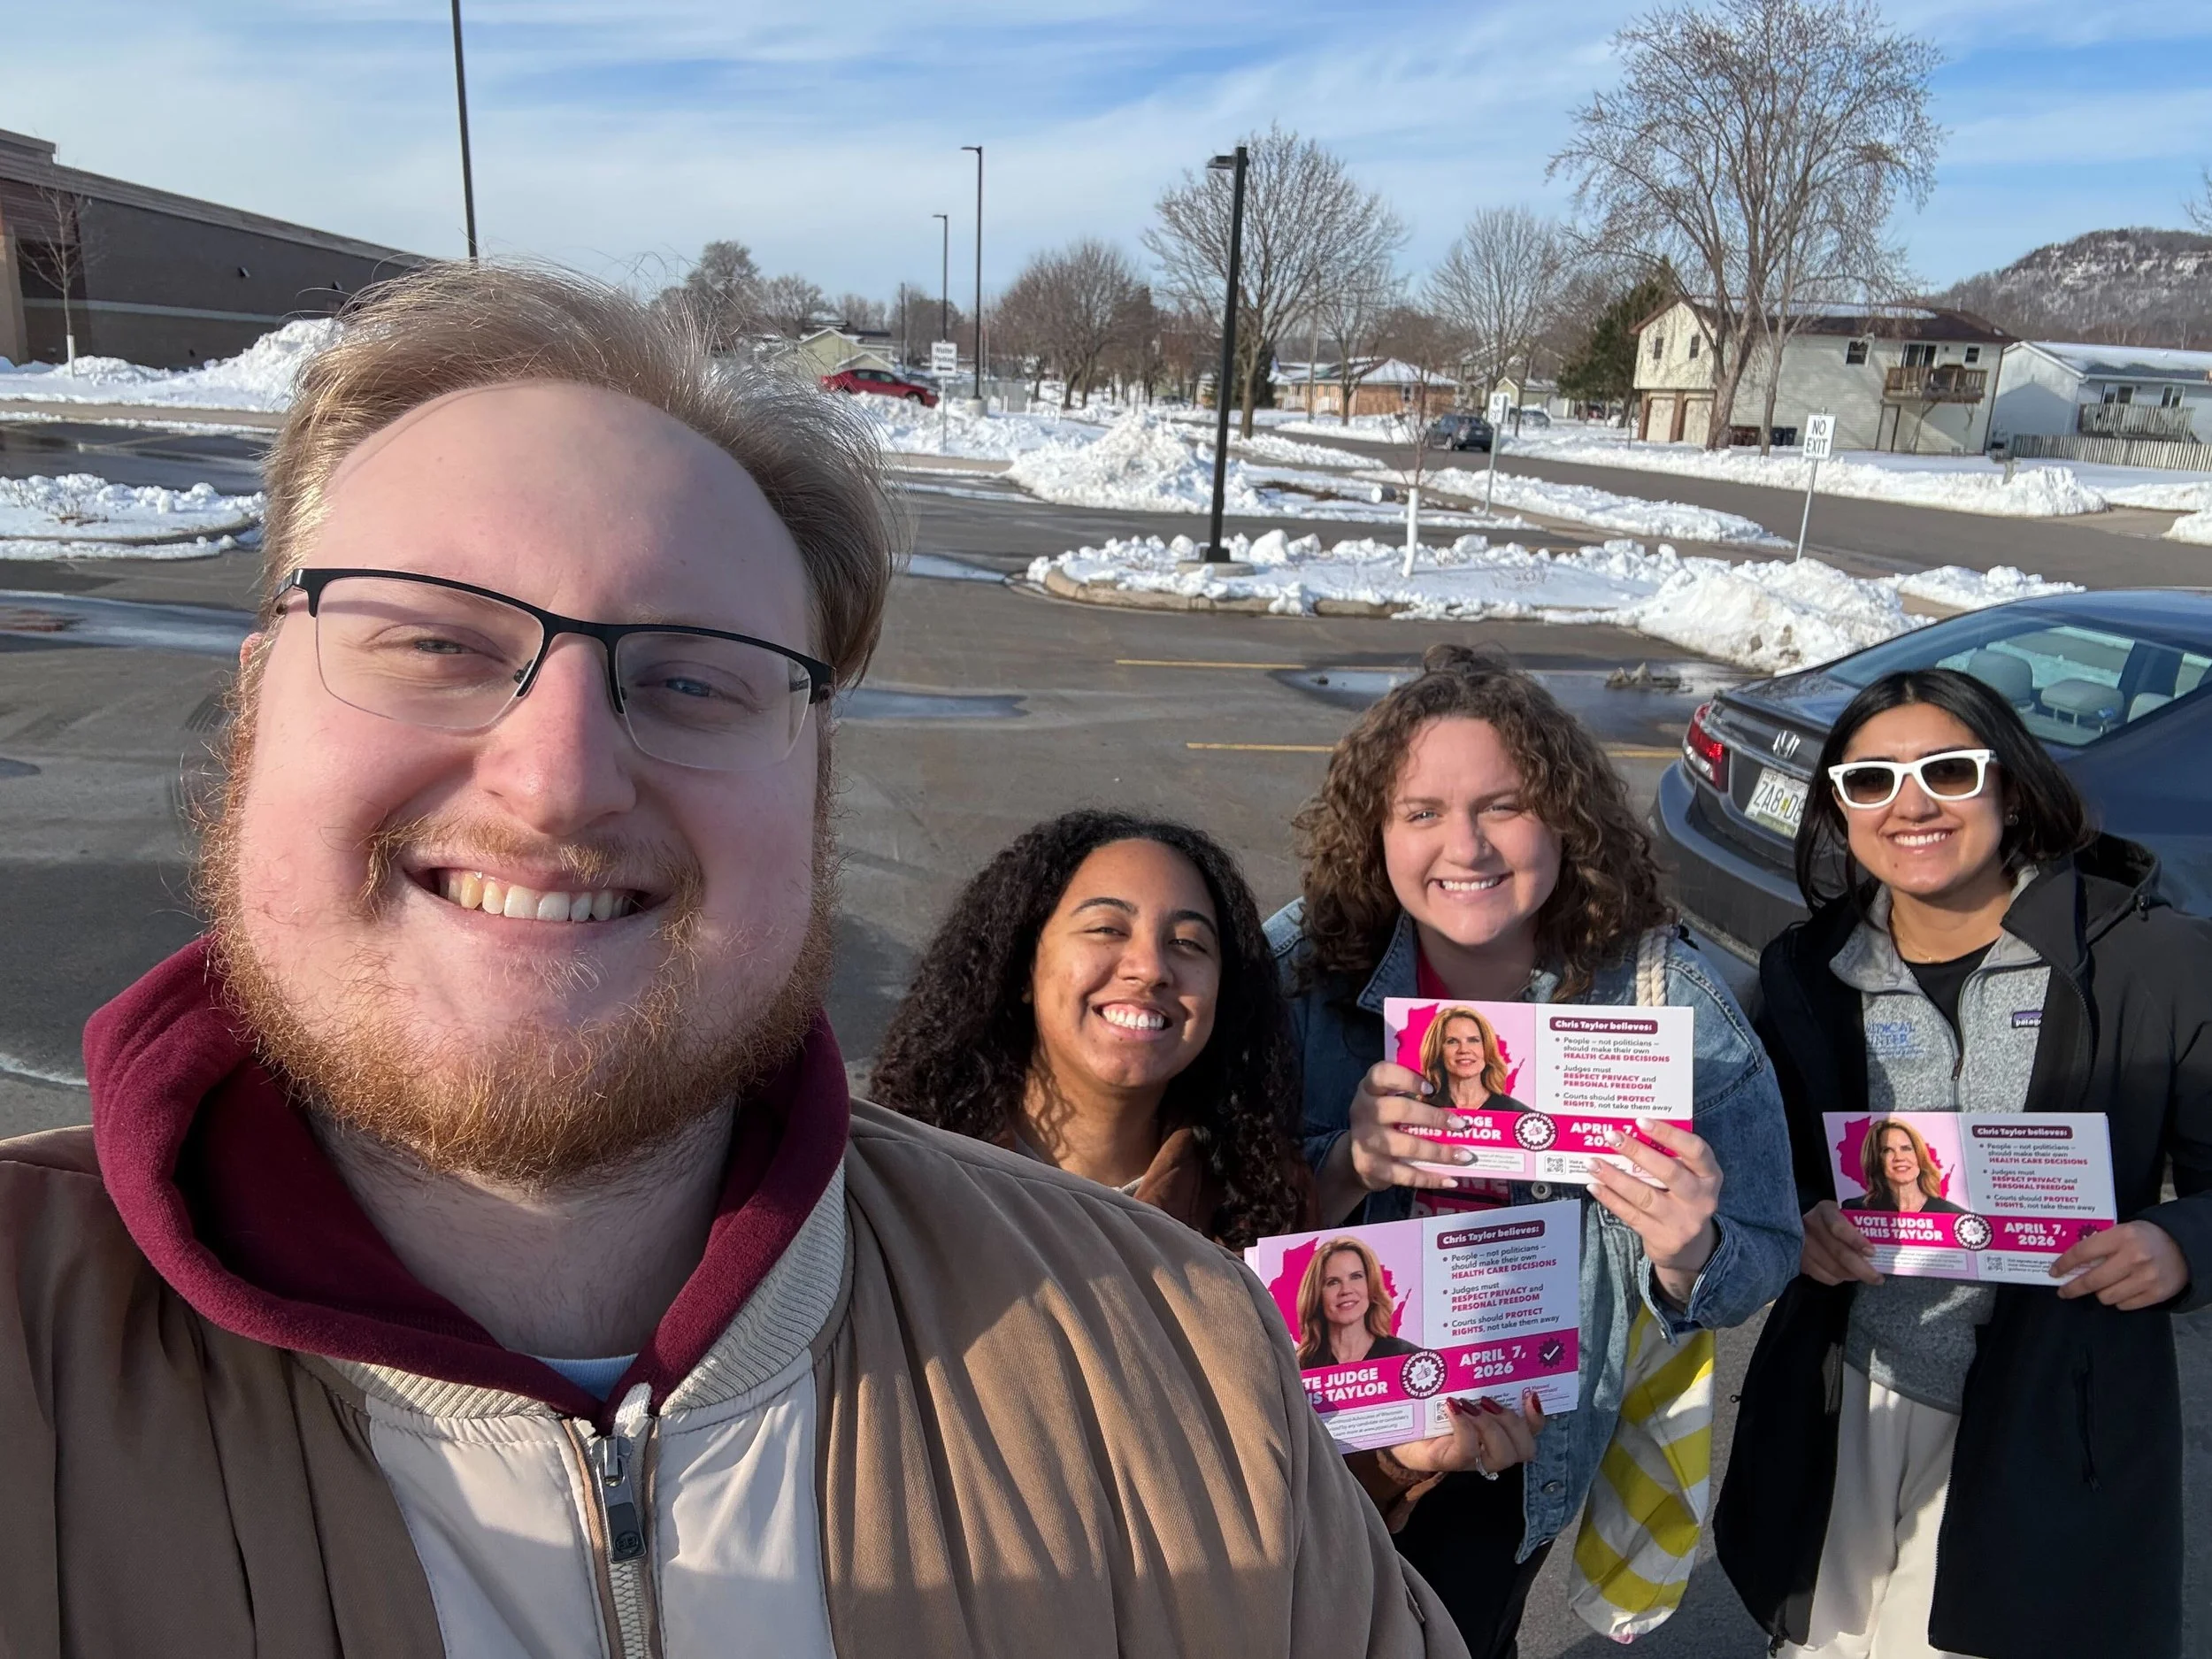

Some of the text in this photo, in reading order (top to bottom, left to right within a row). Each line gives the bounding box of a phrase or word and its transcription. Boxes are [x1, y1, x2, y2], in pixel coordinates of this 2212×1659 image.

[1812, 419, 1826, 435] NO
[1806, 437, 1828, 454] EXIT
[1579, 1021, 1608, 1031] Taylor
[1610, 1022, 1652, 1031] believes:
[1463, 1115, 1494, 1128] DGE
[1623, 1125, 1638, 1138] 7,
[2000, 1128, 2025, 1137] Taylor
[1583, 1136, 1611, 1148] 20
[1854, 1216, 1934, 1230] VOTE JUDGE
[2004, 1222, 2067, 1237] APRIL 7,
[1443, 1225, 1539, 1244] Chris Taylor believes:
[1858, 1227, 1944, 1241] HRIS TAYLOR
[2017, 1234, 2056, 1247] 2026
[1452, 1252, 1478, 1262] People
[1502, 1245, 1539, 1256] politicians
[1452, 1262, 1477, 1271] should
[1452, 1259, 1556, 1279] HEALTH CARE DECISIONS
[1452, 1282, 1499, 1295] Judges must
[1452, 1293, 1487, 1303] RESPECT
[1490, 1286, 1527, 1297] PRIVACY
[1452, 1294, 1540, 1312] PERSONAL FREEDOM
[1452, 1308, 1542, 1327] Courts should PROTECT
[1452, 1325, 1486, 1336] RIGHTS,
[1540, 1315, 1560, 1324] away
[1460, 1345, 1527, 1367] APRIL 7,
[1473, 1361, 1514, 1379] 2026
[1302, 1367, 1379, 1390] TE JUDGE
[1325, 1381, 1388, 1402] TAYLOR
